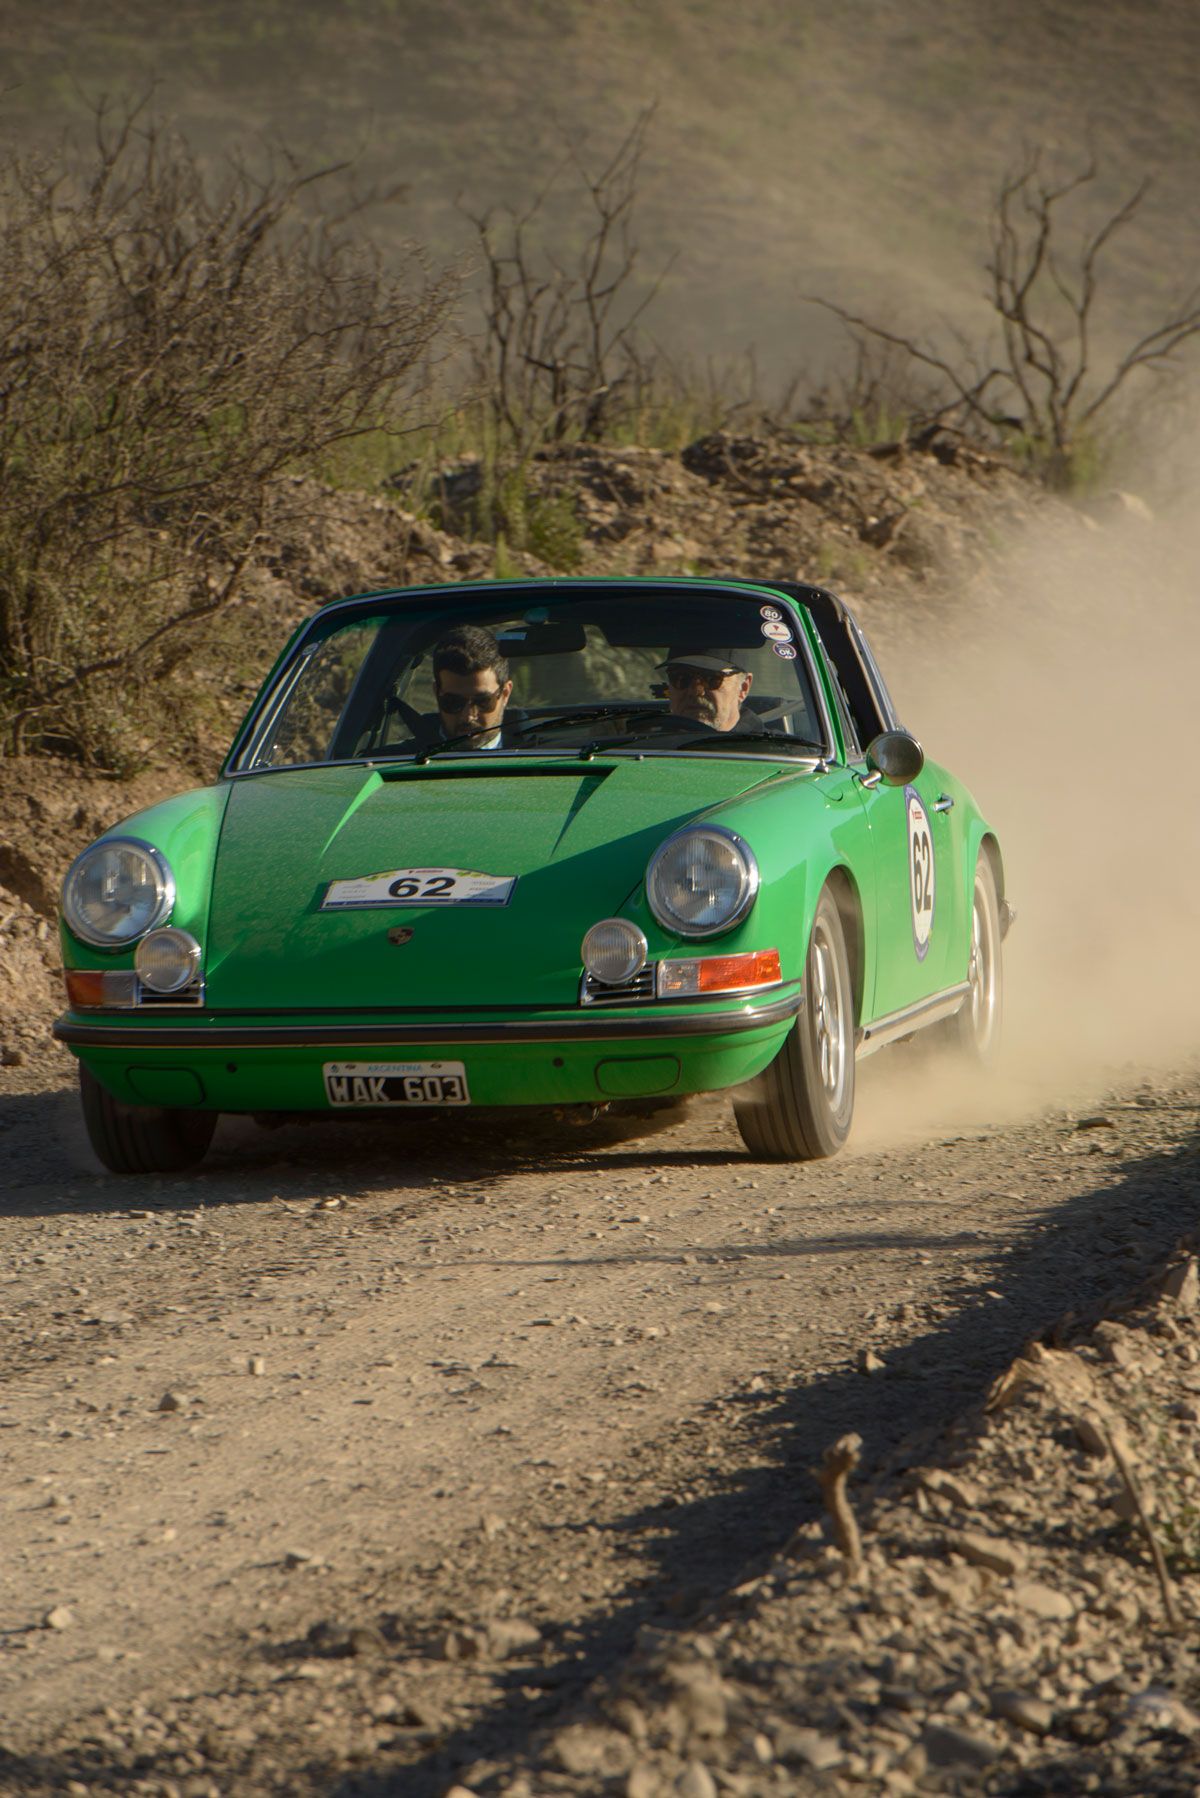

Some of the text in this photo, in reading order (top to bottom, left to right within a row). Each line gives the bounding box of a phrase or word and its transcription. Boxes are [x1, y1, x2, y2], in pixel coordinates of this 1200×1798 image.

[913, 830, 931, 914] 62
[388, 877, 456, 898] 62
[368, 1063, 423, 1073] ARGENTINA
[330, 1076, 463, 1102] WAK 603
